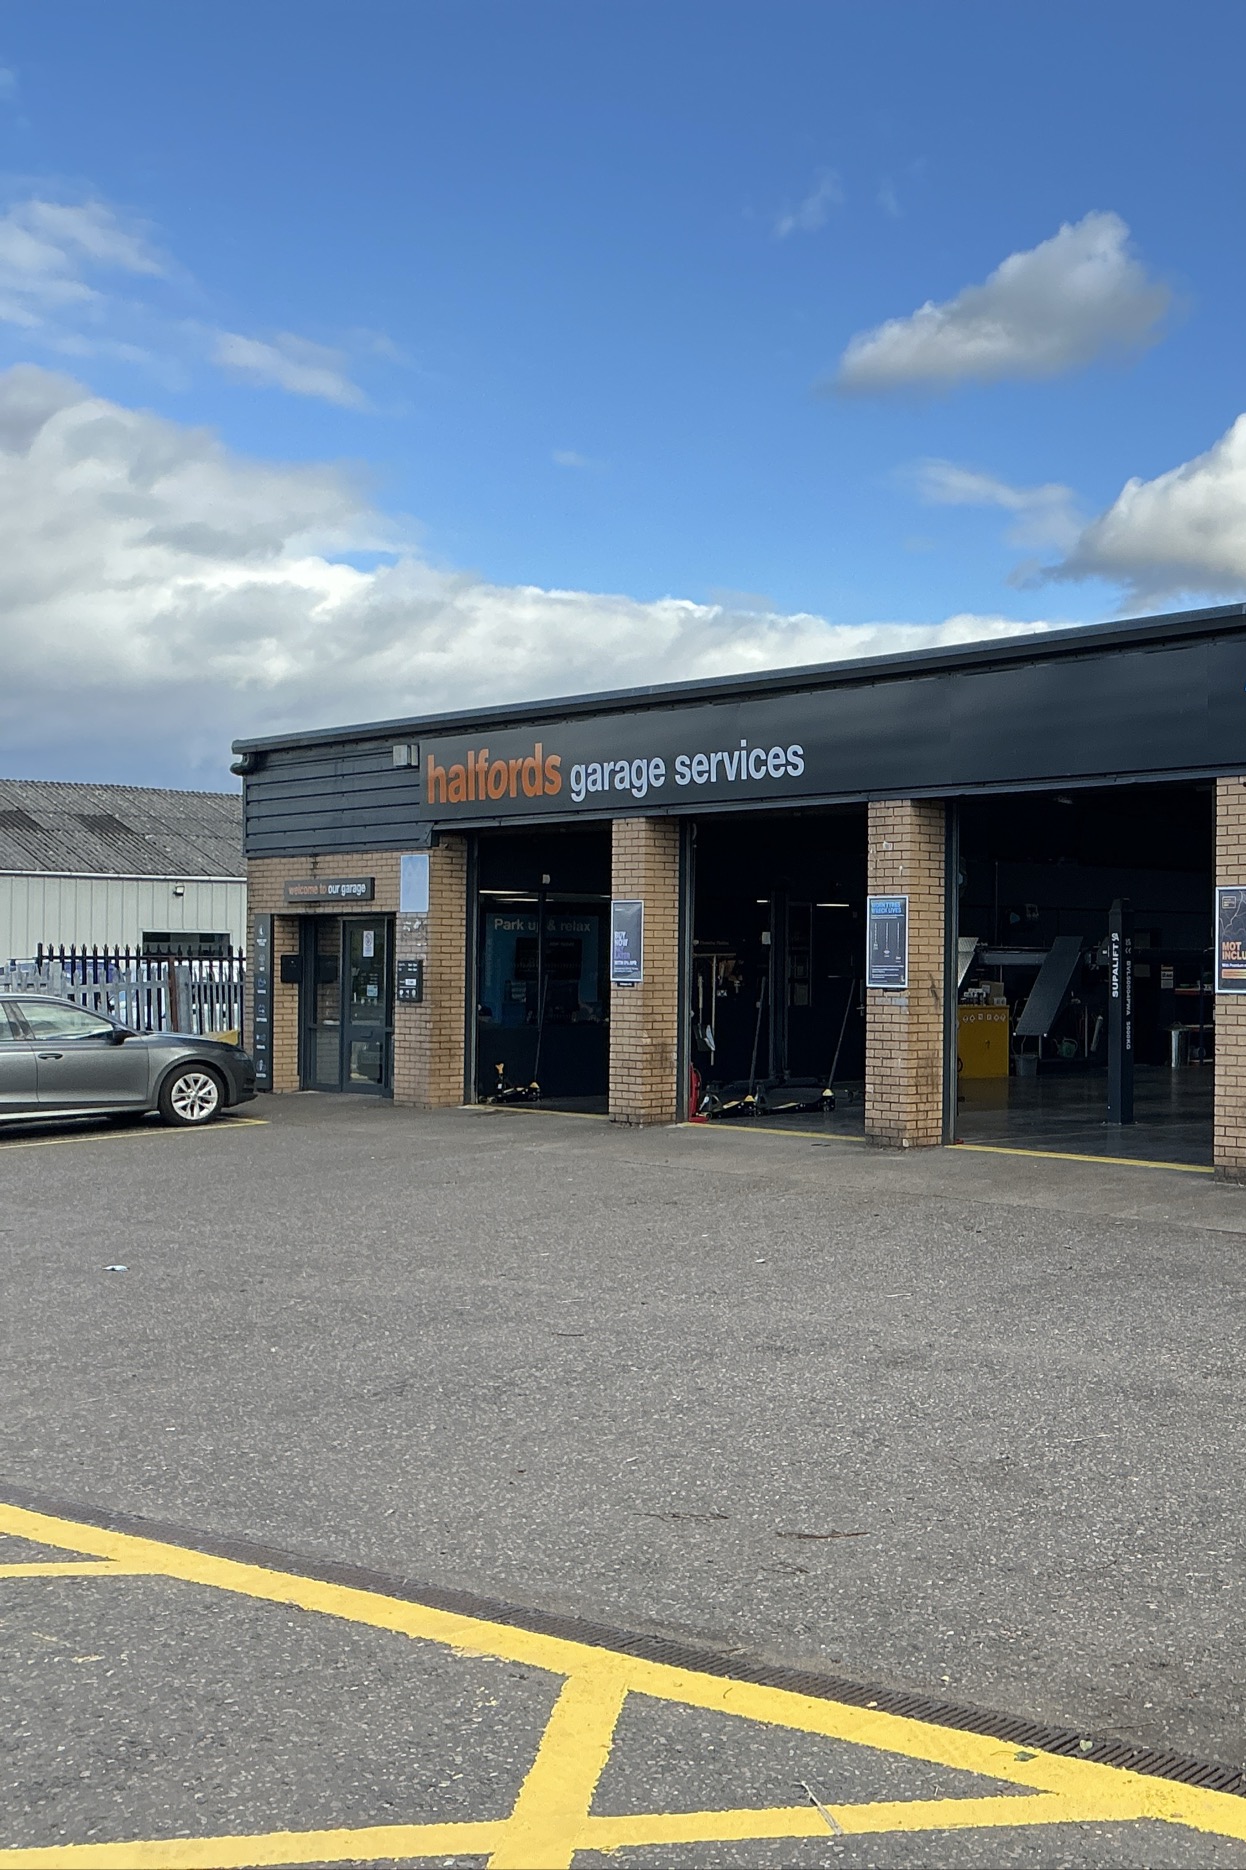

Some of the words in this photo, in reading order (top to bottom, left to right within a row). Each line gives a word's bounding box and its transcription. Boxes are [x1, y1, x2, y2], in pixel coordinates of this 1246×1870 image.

[427, 742, 562, 805] halfords
[570, 754, 665, 802] garage
[674, 739, 805, 786] services
[288, 884, 318, 896] welcome
[319, 884, 327, 895] to
[328, 884, 339, 895] our
[341, 883, 367, 897] garage
[494, 918, 524, 931] Park
[528, 922, 538, 934] u
[546, 919, 556, 931] &
[561, 920, 591, 932] relax
[1222, 941, 1242, 951] MOT
[1111, 944, 1119, 998] SUPALIFT
